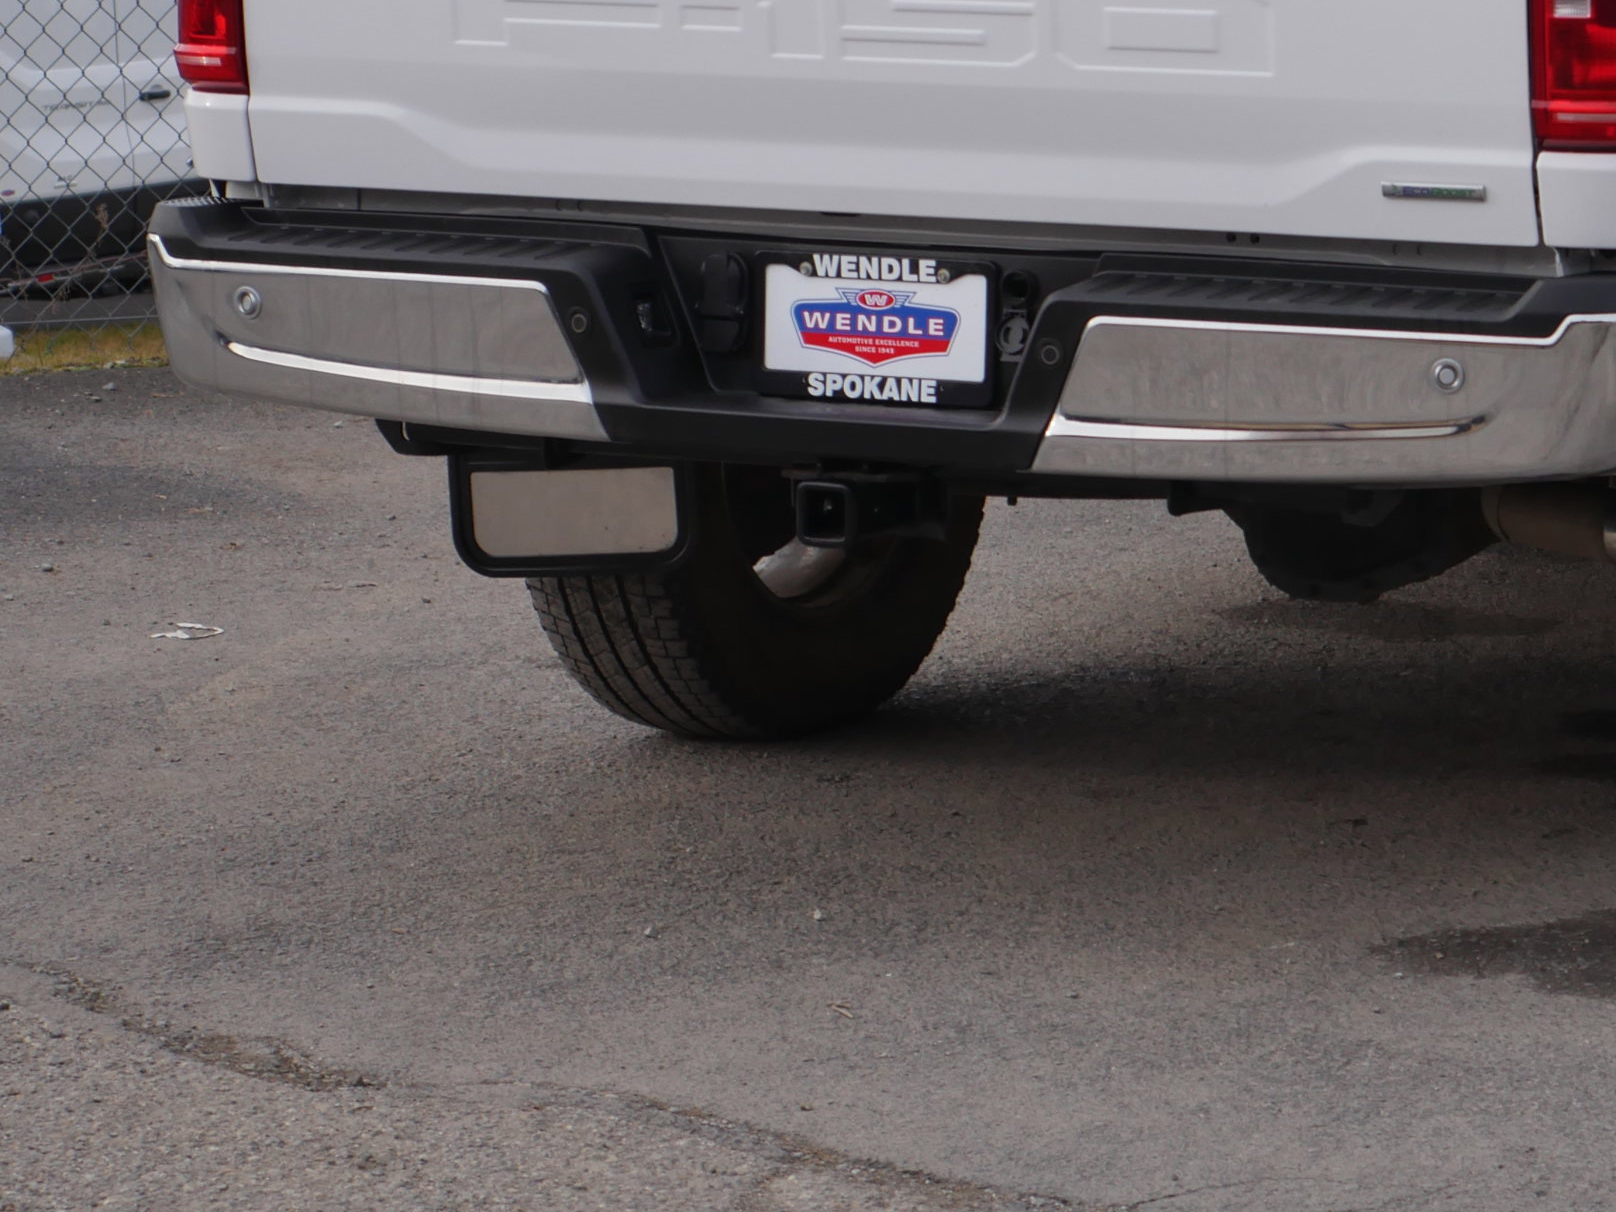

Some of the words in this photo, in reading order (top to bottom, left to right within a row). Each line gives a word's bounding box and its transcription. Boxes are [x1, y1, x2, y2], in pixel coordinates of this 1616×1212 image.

[813, 253, 937, 283] WENDLE
[803, 311, 945, 336] WENDLE
[828, 336, 873, 345] AUTOMOTIVE
[875, 338, 919, 348] EXCELLENCE
[807, 372, 937, 403] SPOKANE
